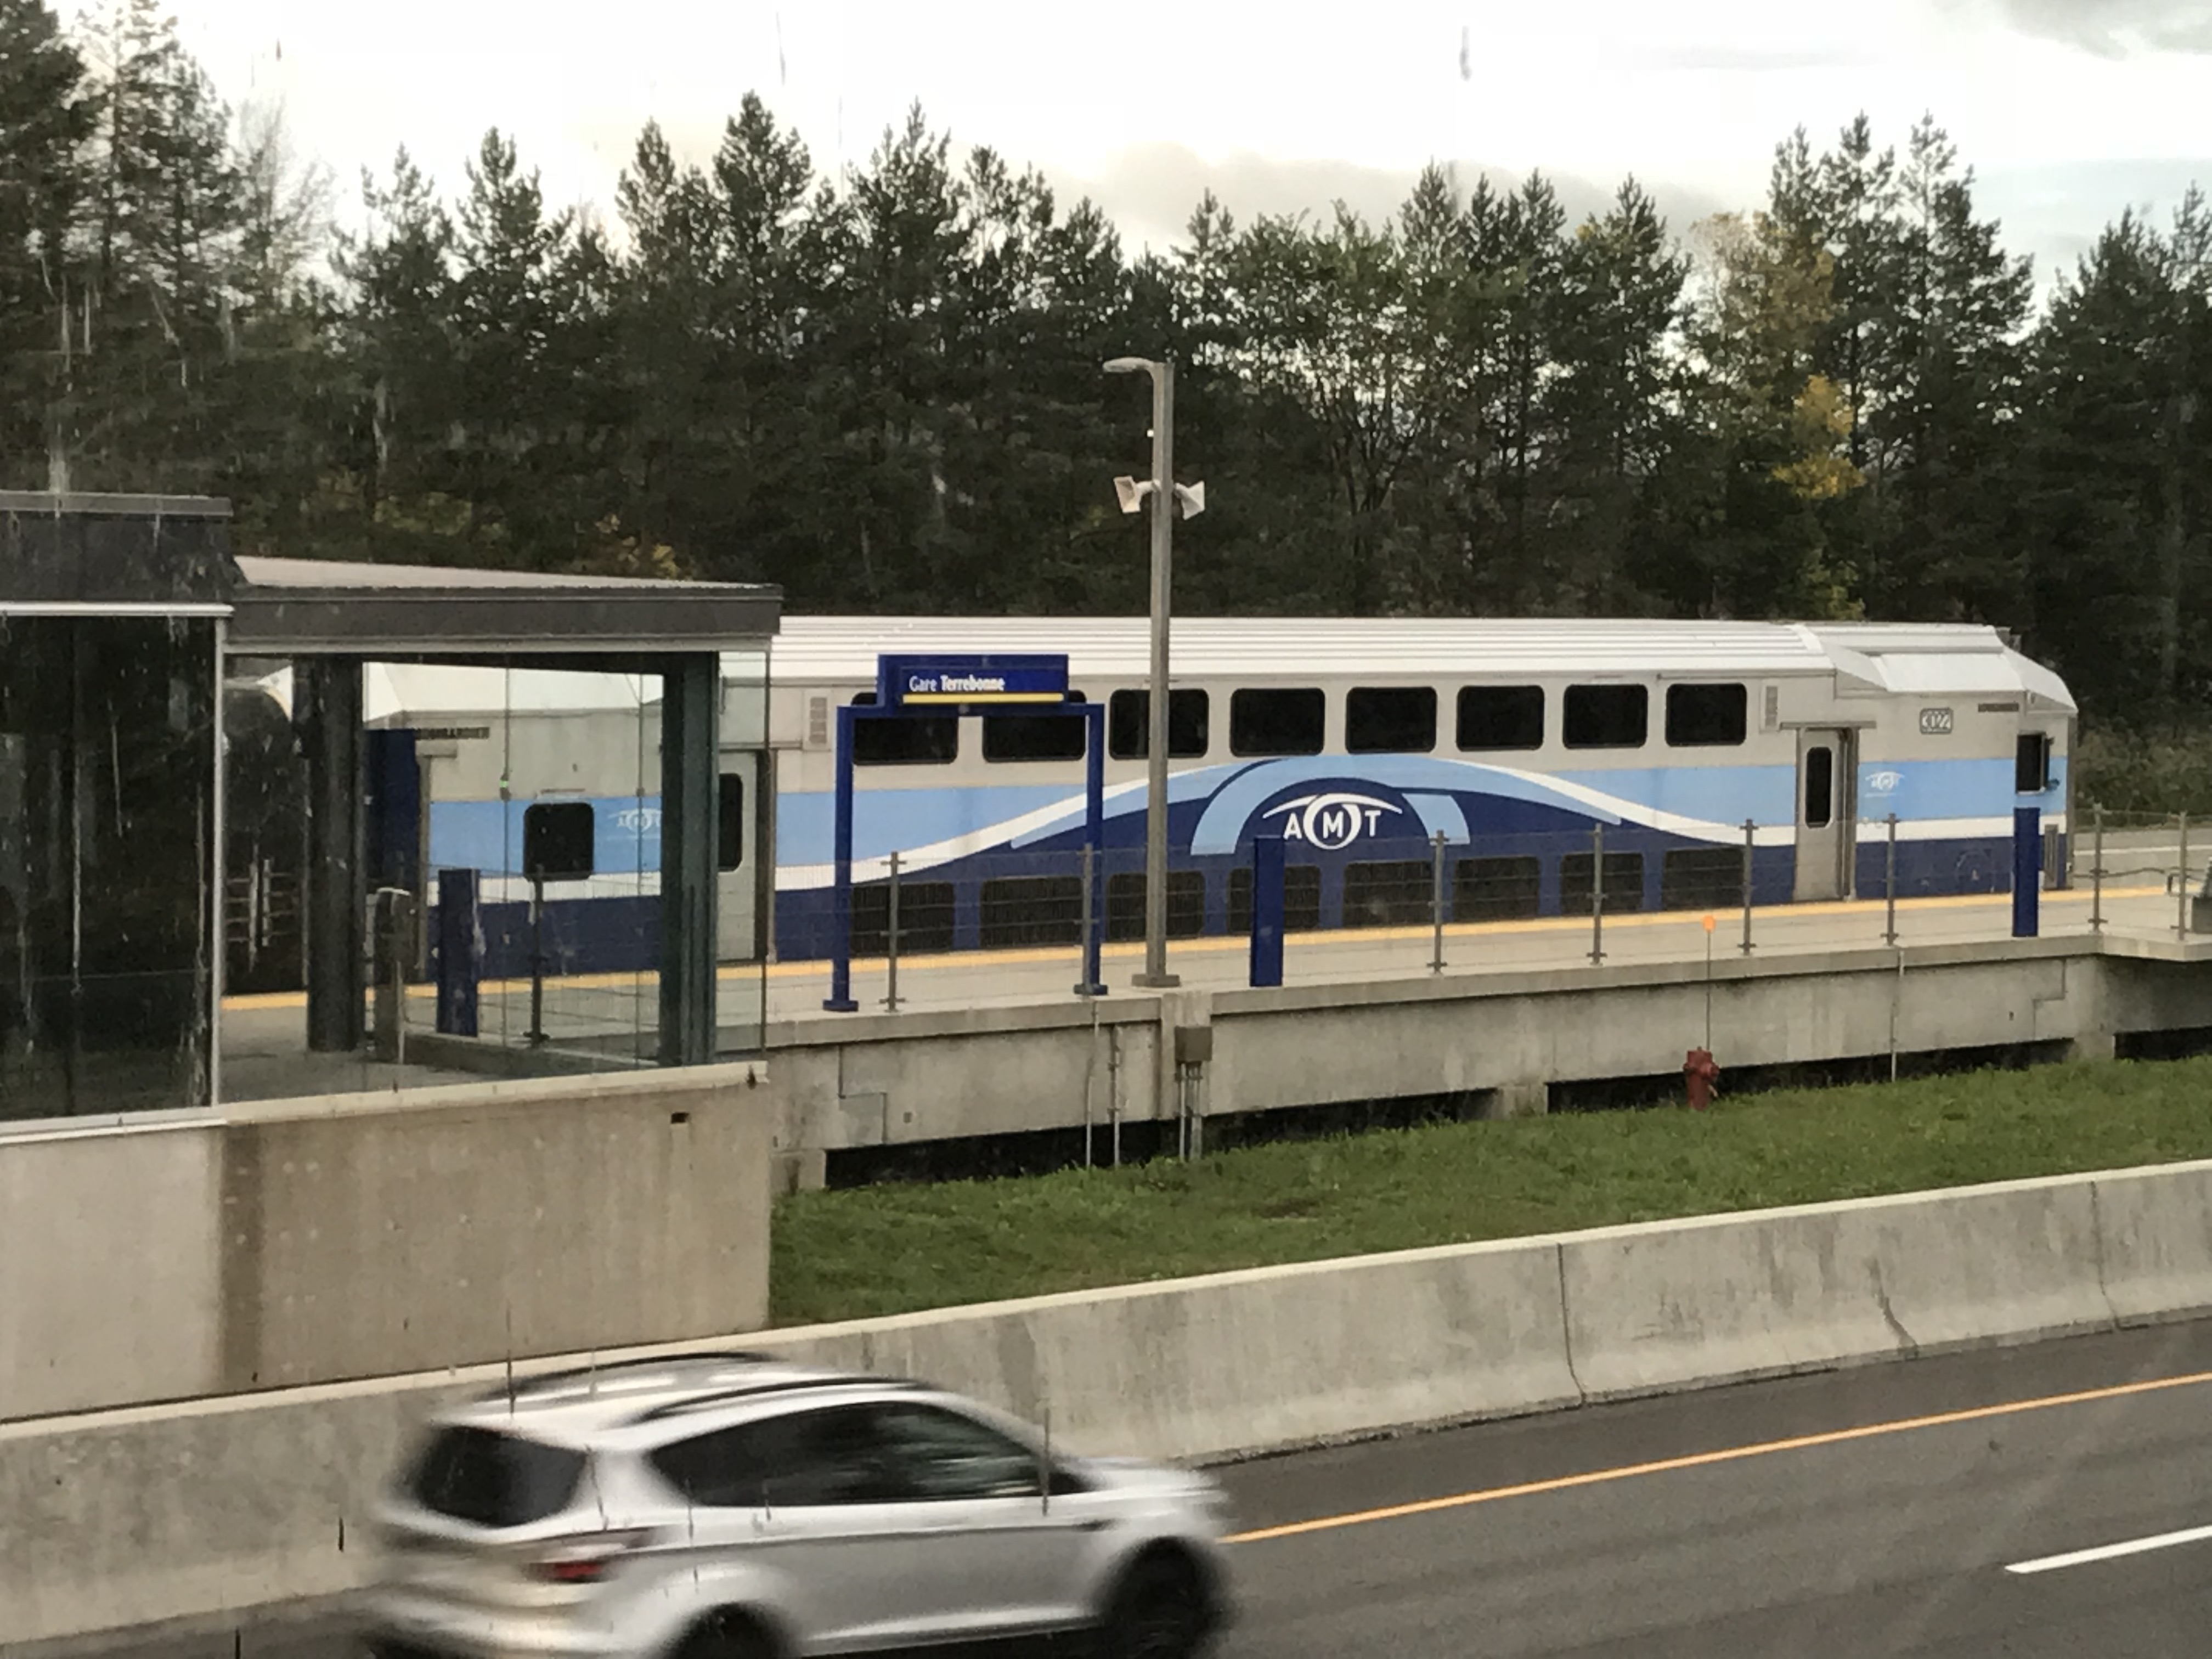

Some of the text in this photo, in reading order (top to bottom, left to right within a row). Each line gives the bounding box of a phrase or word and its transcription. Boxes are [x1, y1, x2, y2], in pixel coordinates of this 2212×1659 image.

[909, 674, 1006, 692] Gare Terrebonne
[1283, 809, 1381, 840] AMT
